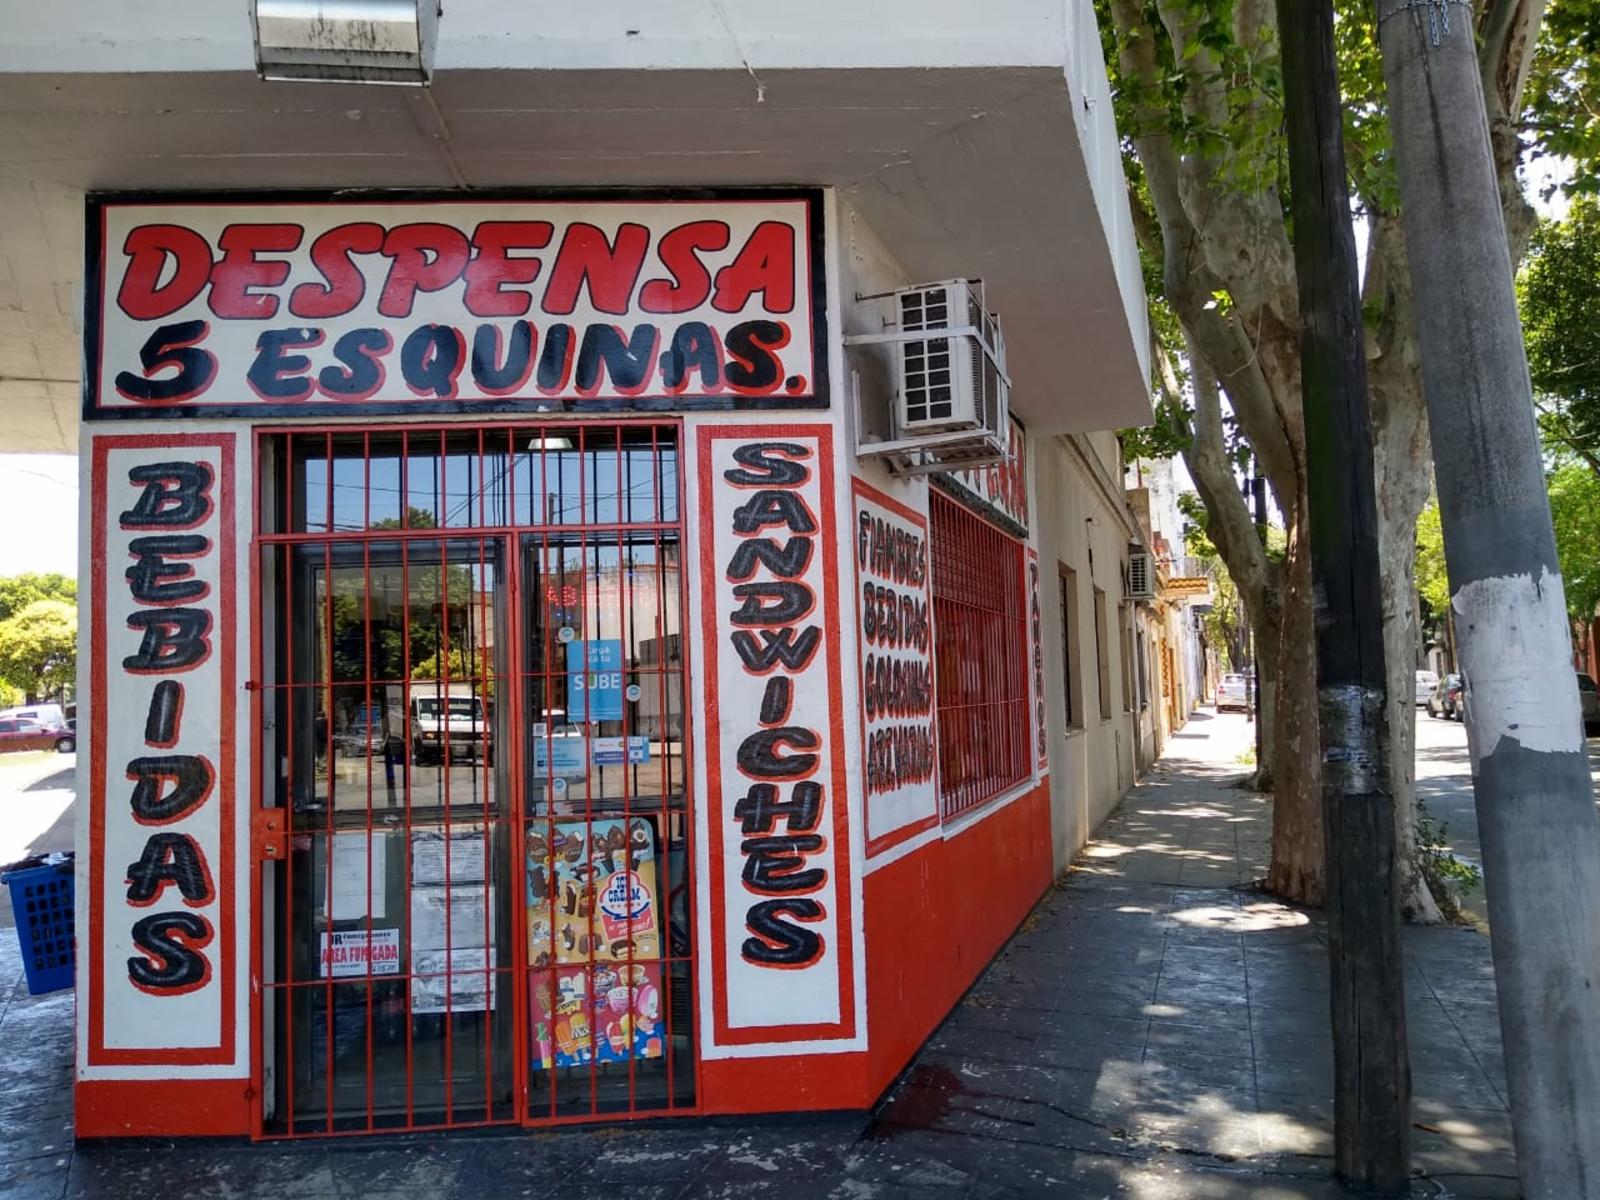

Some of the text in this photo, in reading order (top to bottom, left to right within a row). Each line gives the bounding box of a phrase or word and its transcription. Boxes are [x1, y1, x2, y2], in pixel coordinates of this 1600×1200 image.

[117, 220, 795, 320] DESPENSA
[115, 320, 806, 403] 5 ESQUINAS.
[859, 510, 926, 590] FIAMBRES
[863, 581, 928, 655] BEBIDAS
[574, 673, 621, 691] SUBE
[723, 442, 828, 971] SANDWICHES
[119, 461, 214, 995] BEBIDAS
[609, 888, 641, 902] CREM
[616, 876, 631, 889] IC
[349, 944, 398, 962] FUMGADA
